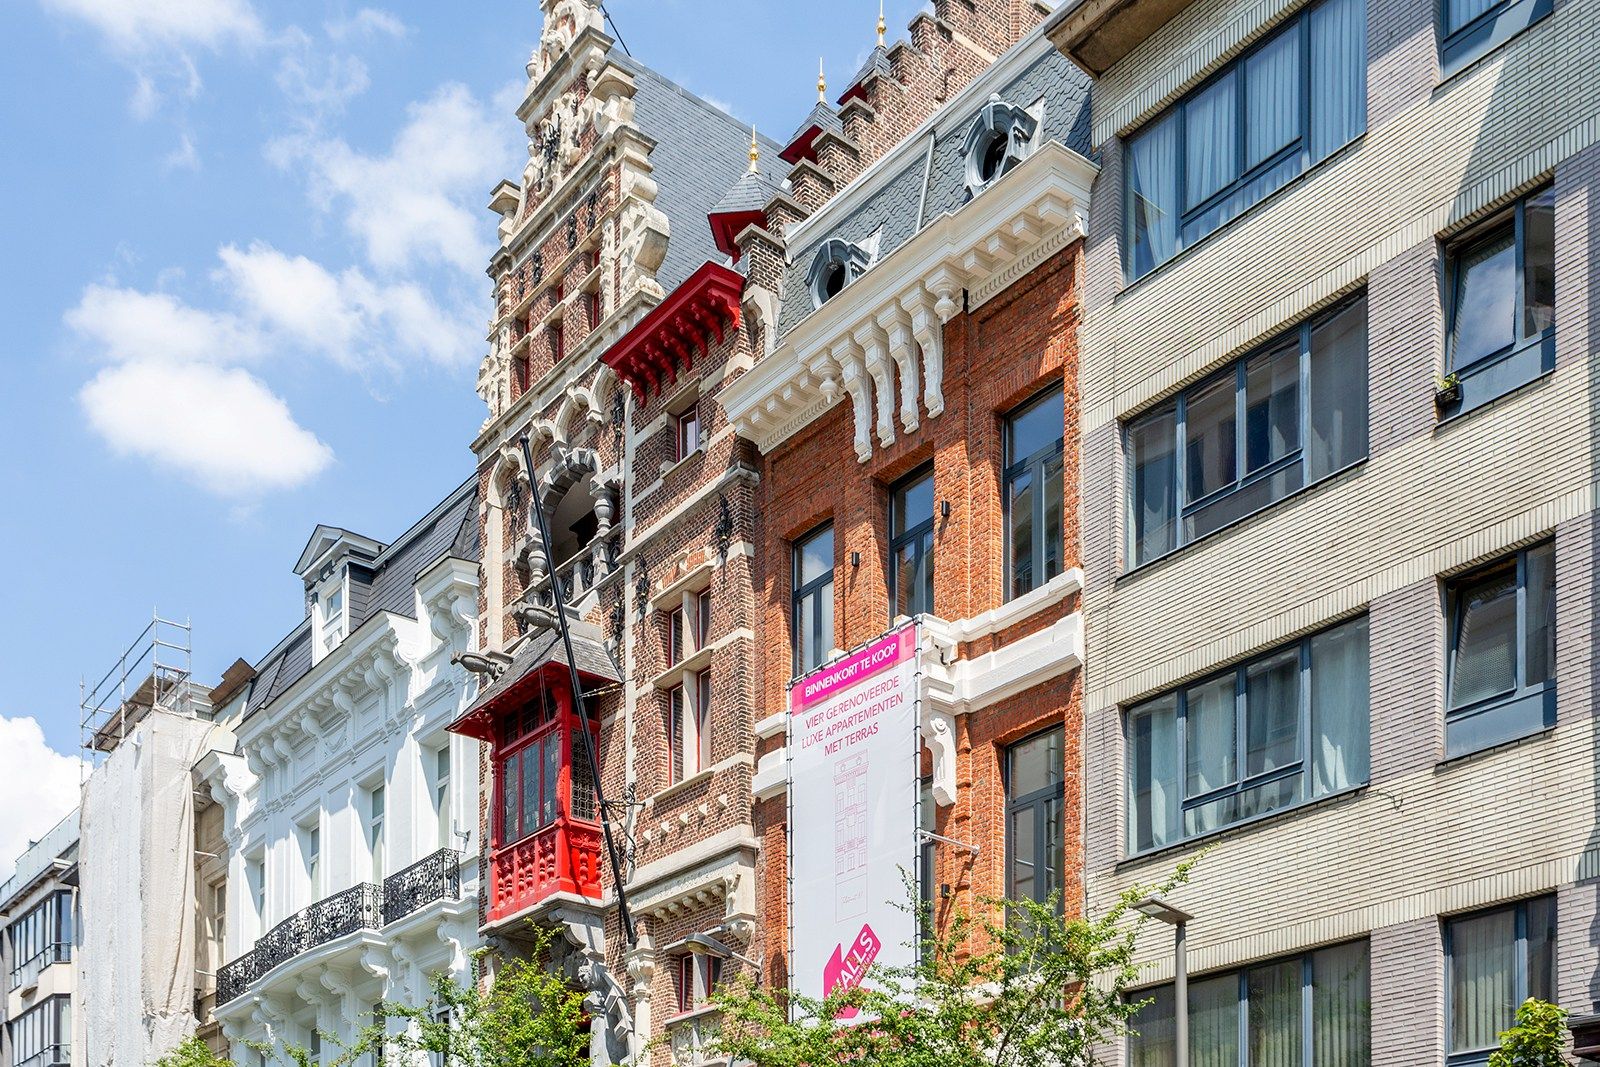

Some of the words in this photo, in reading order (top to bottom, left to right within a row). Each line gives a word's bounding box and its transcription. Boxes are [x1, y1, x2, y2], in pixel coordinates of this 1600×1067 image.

[805, 664, 858, 698] BINNENKORT
[860, 657, 871, 672] TE
[871, 643, 897, 666] KOOP
[801, 730, 824, 750] LUXE
[825, 692, 904, 739] APPARTEMENTEN
[805, 713, 825, 730] VIER
[826, 675, 900, 720] GERENOVEERDE
[824, 738, 844, 757] MET
[845, 722, 879, 747] TERRAS
